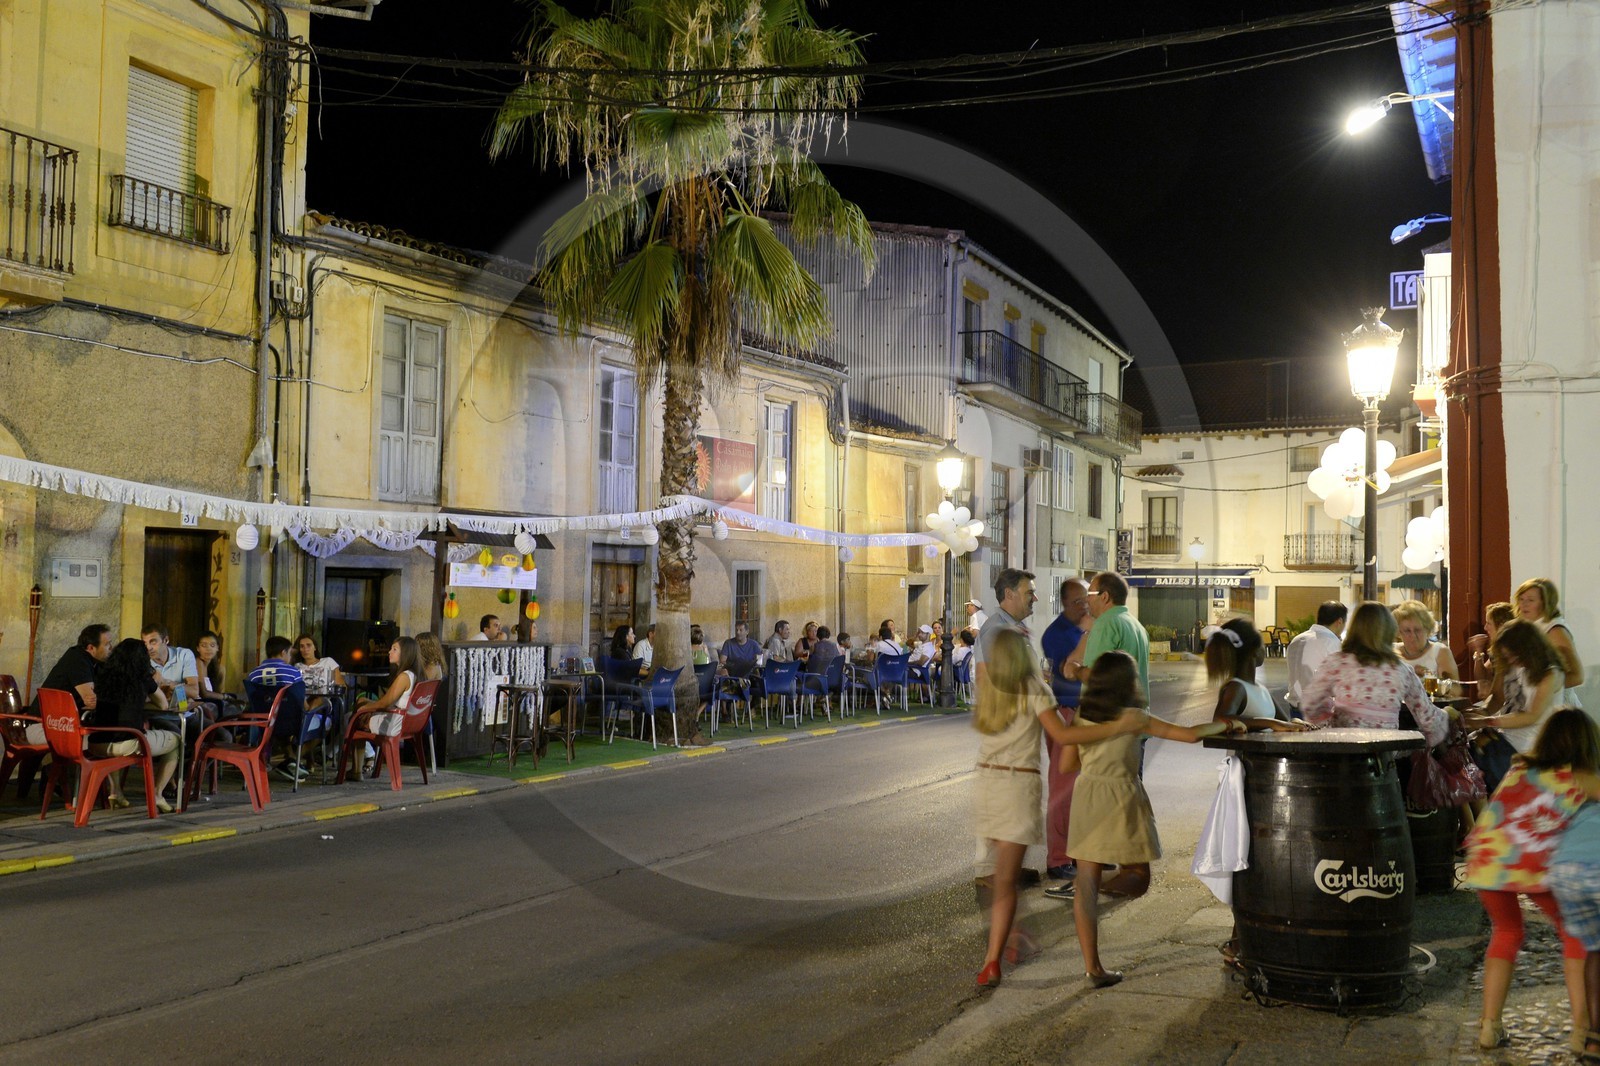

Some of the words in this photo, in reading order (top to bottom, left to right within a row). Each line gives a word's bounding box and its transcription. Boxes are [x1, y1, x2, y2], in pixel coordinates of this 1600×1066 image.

[1395, 274, 1424, 304] TA
[230, 551, 241, 565] 31
[1155, 577, 1190, 586] BAILES
[1207, 577, 1241, 586] BODAS
[262, 667, 277, 687] 6
[1313, 859, 1404, 896] Carlsberg
